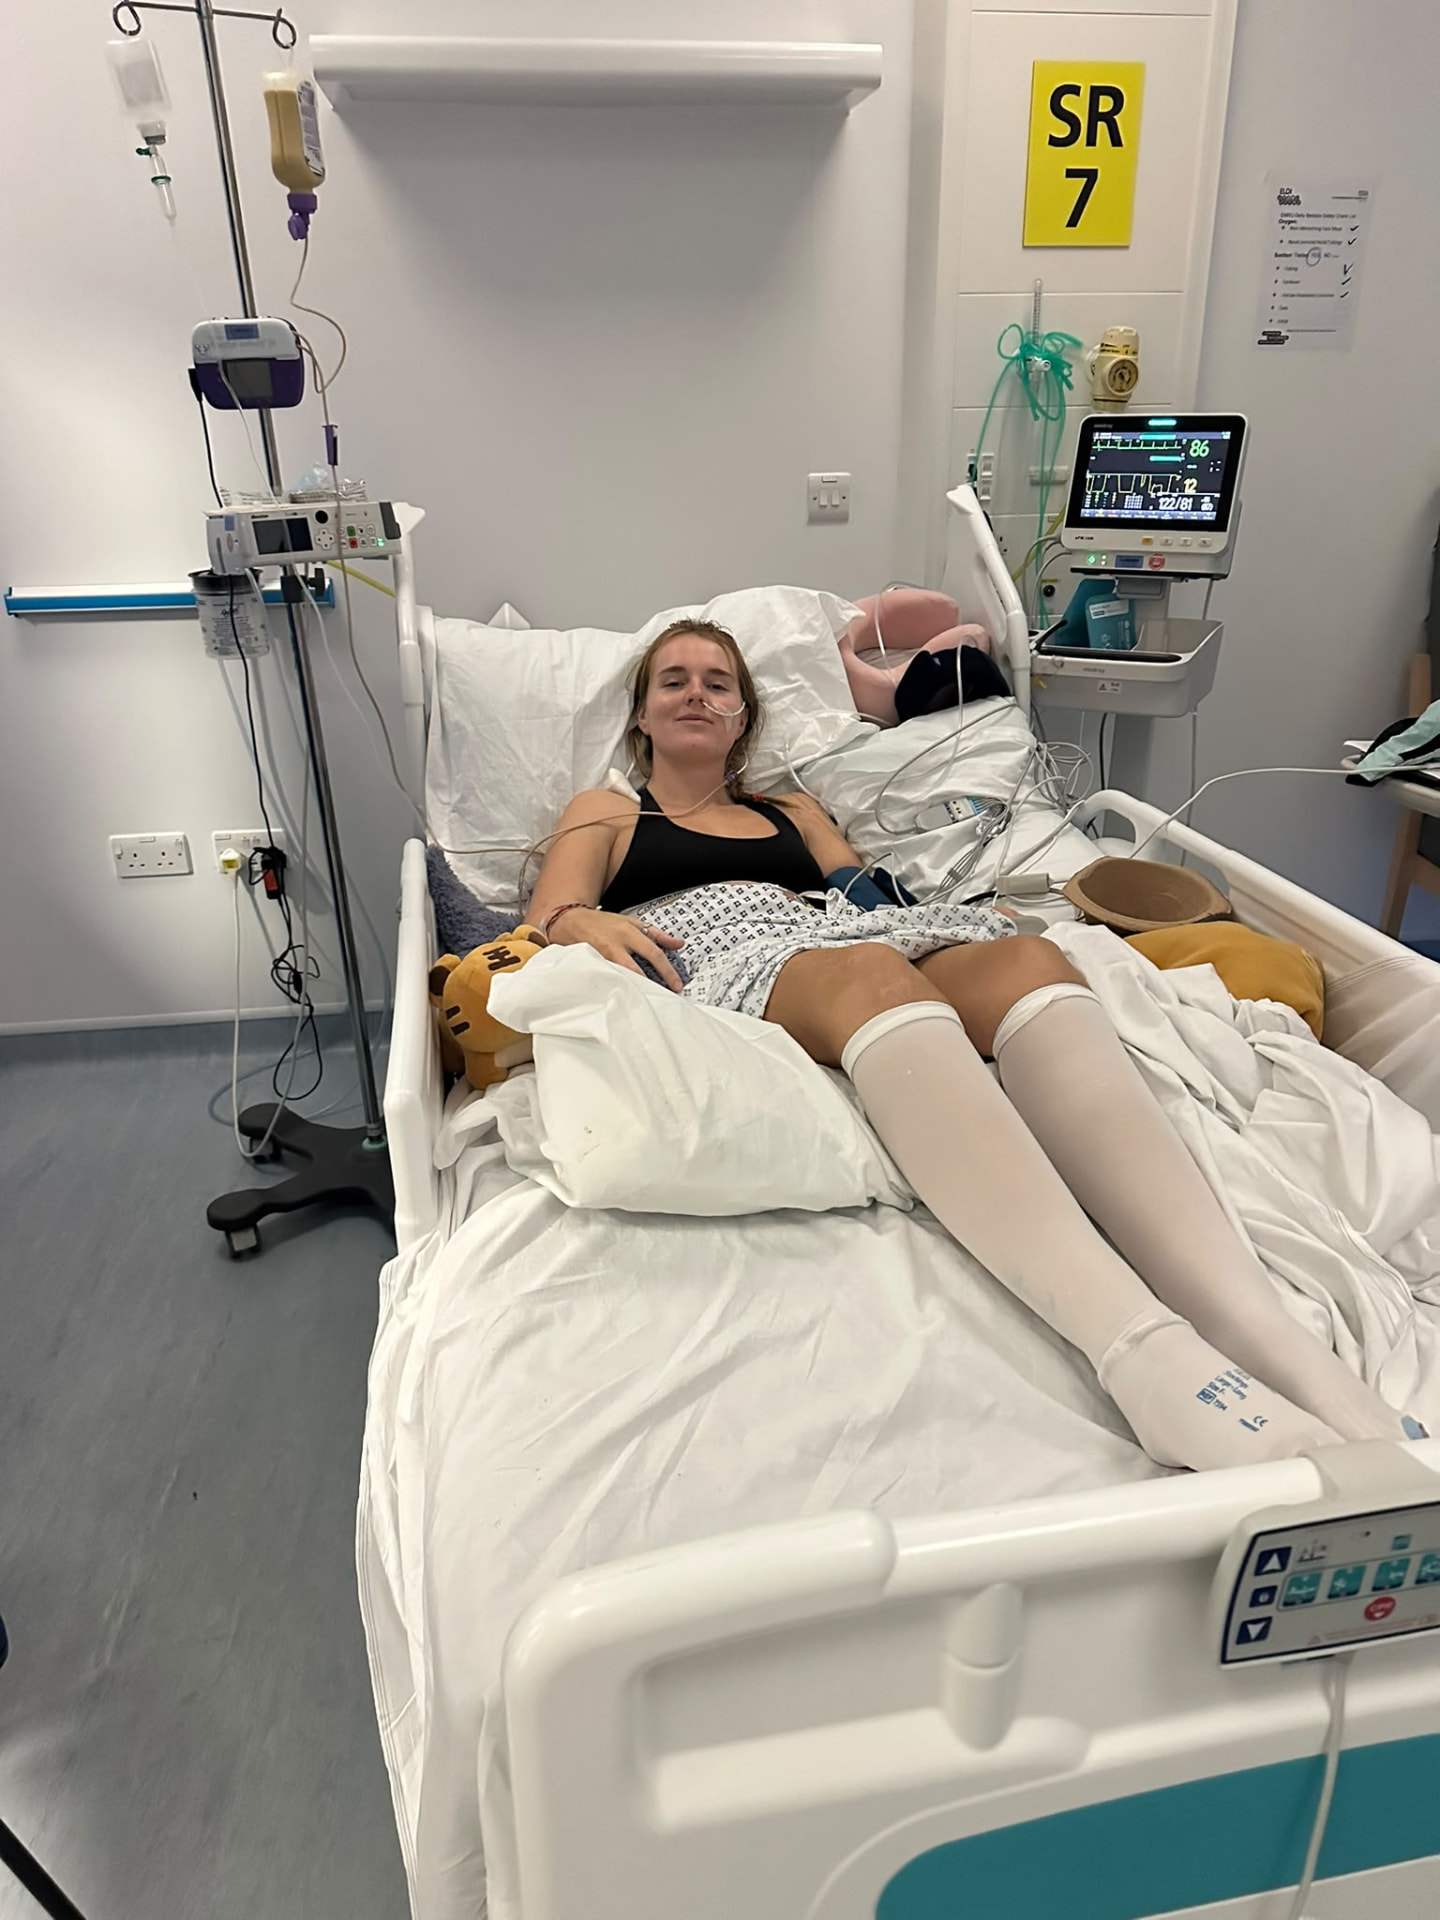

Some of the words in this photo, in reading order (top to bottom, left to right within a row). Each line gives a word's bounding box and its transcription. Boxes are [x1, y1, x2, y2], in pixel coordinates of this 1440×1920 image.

[1048, 84, 1124, 148] SR
[1065, 168, 1099, 228] 7
[1189, 439, 1210, 458] 86
[1183, 478, 1198, 494] 12
[1158, 497, 1193, 511] 122/81
